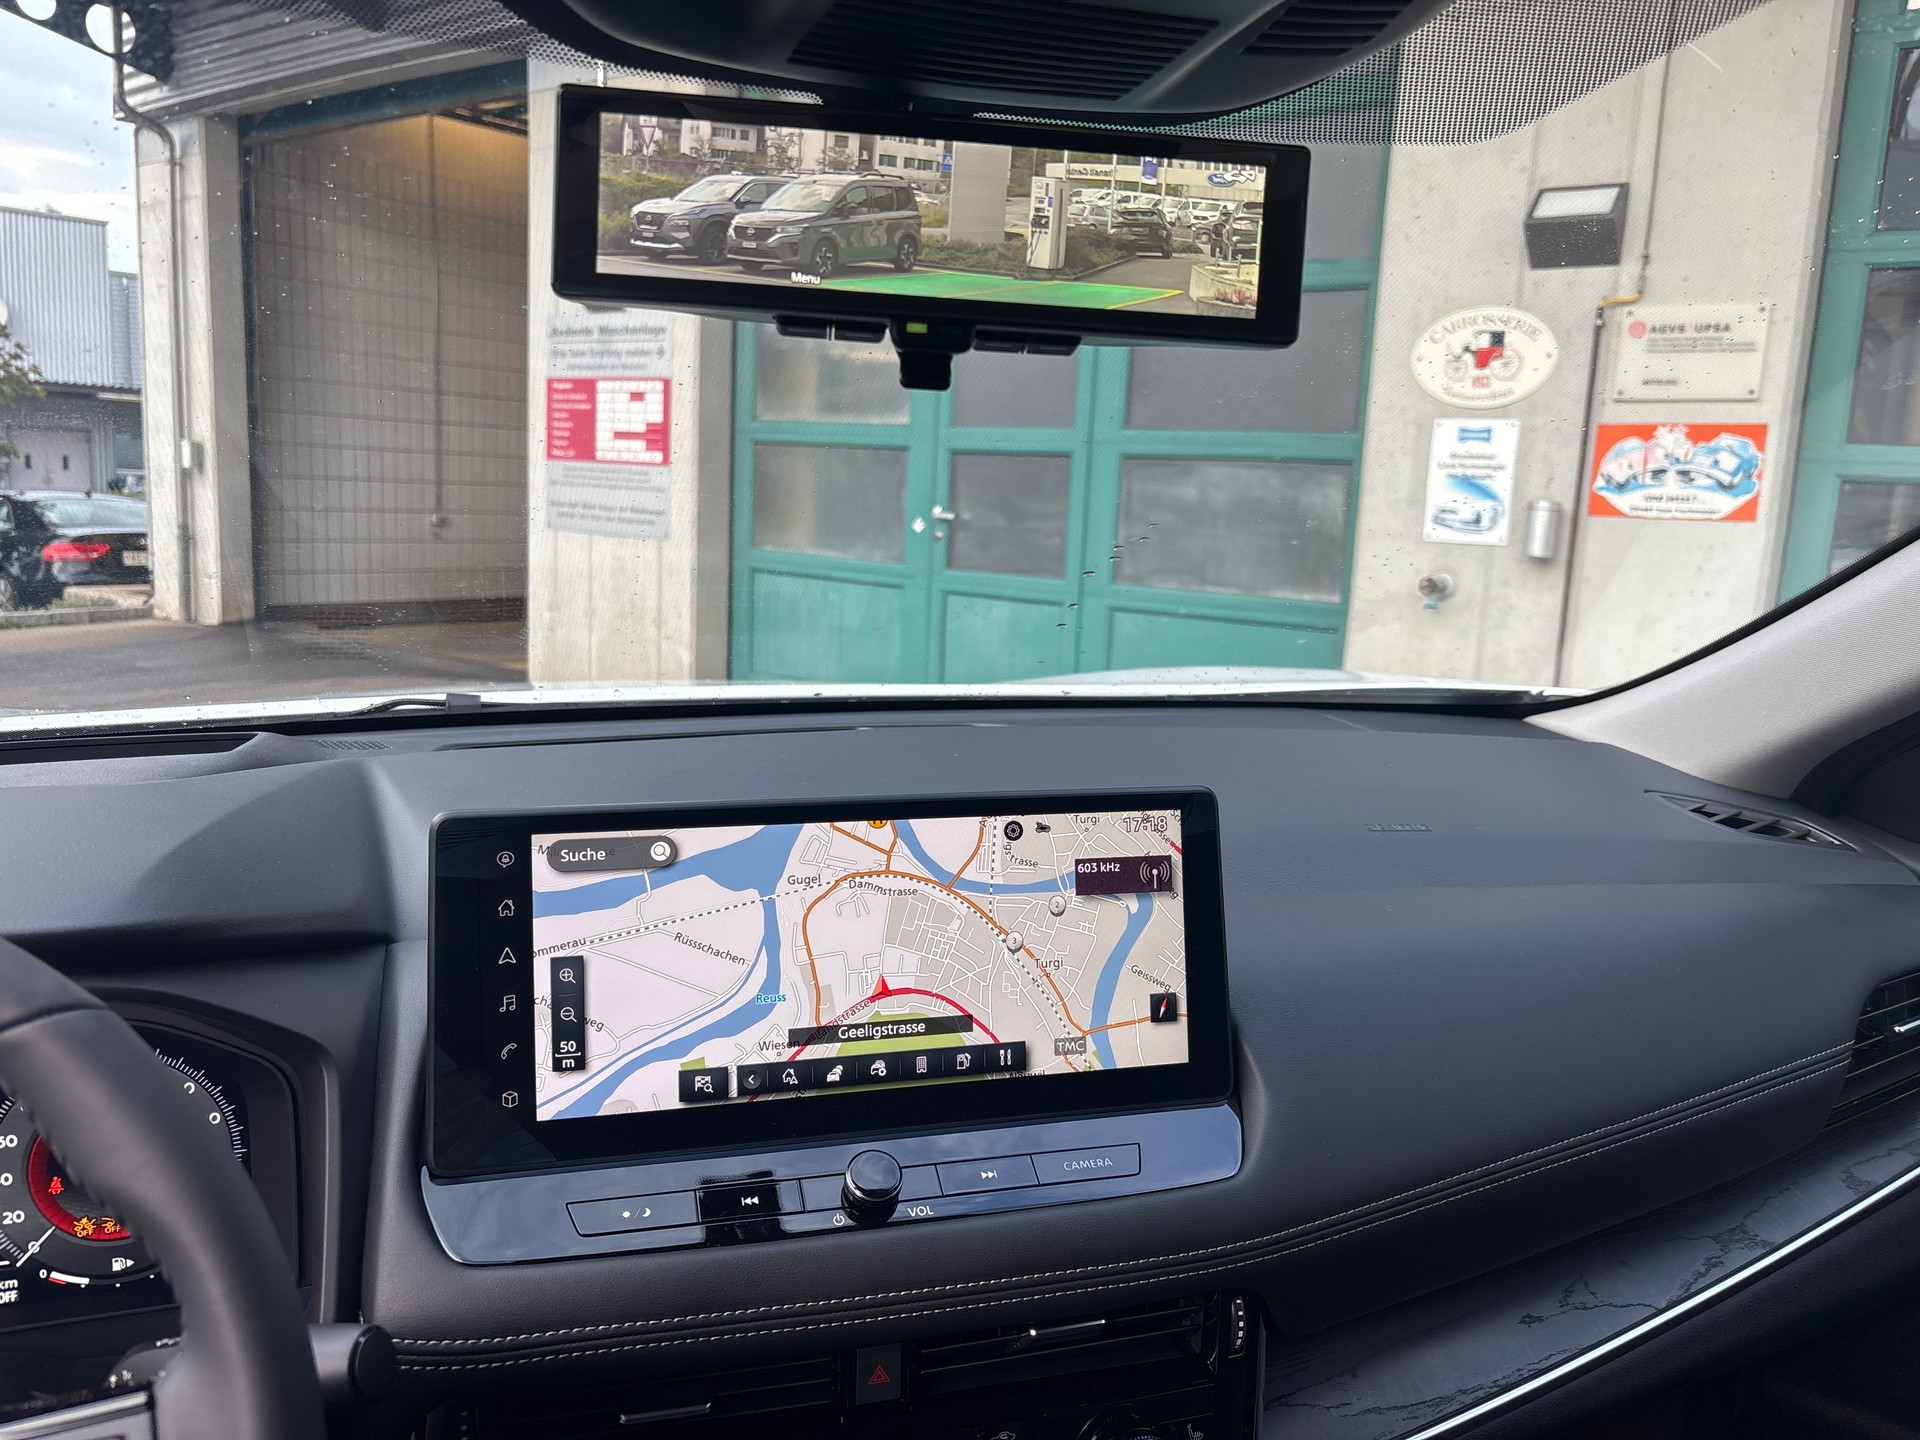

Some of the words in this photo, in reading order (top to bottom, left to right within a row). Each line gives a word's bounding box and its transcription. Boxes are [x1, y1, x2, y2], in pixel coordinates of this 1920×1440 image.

[790, 271, 821, 285] Menu
[1073, 814, 1101, 826] Turgi
[1122, 814, 1168, 833] 17:18
[560, 848, 606, 862] Suche
[1077, 862, 1098, 873] 603
[1100, 862, 1121, 872] kHz
[787, 873, 822, 887] Gugel
[848, 879, 918, 897] Dammstrasse
[674, 931, 746, 967] Rüssschachen
[1033, 957, 1064, 970] Turgi
[1130, 963, 1172, 993] Geissweg
[755, 992, 787, 1005] Reuss
[838, 1021, 926, 1039] Geeligstrasse
[560, 1041, 577, 1052] 50
[757, 1039, 801, 1052] Wiesen
[1056, 1041, 1087, 1053] TMC
[562, 1059, 575, 1068] m
[1063, 1157, 1113, 1171] CAMERA
[2, 1210, 25, 1225] 20
[907, 1205, 934, 1217] VOL
[76, 1228, 95, 1238] OFF
[103, 1225, 121, 1234] OFF
